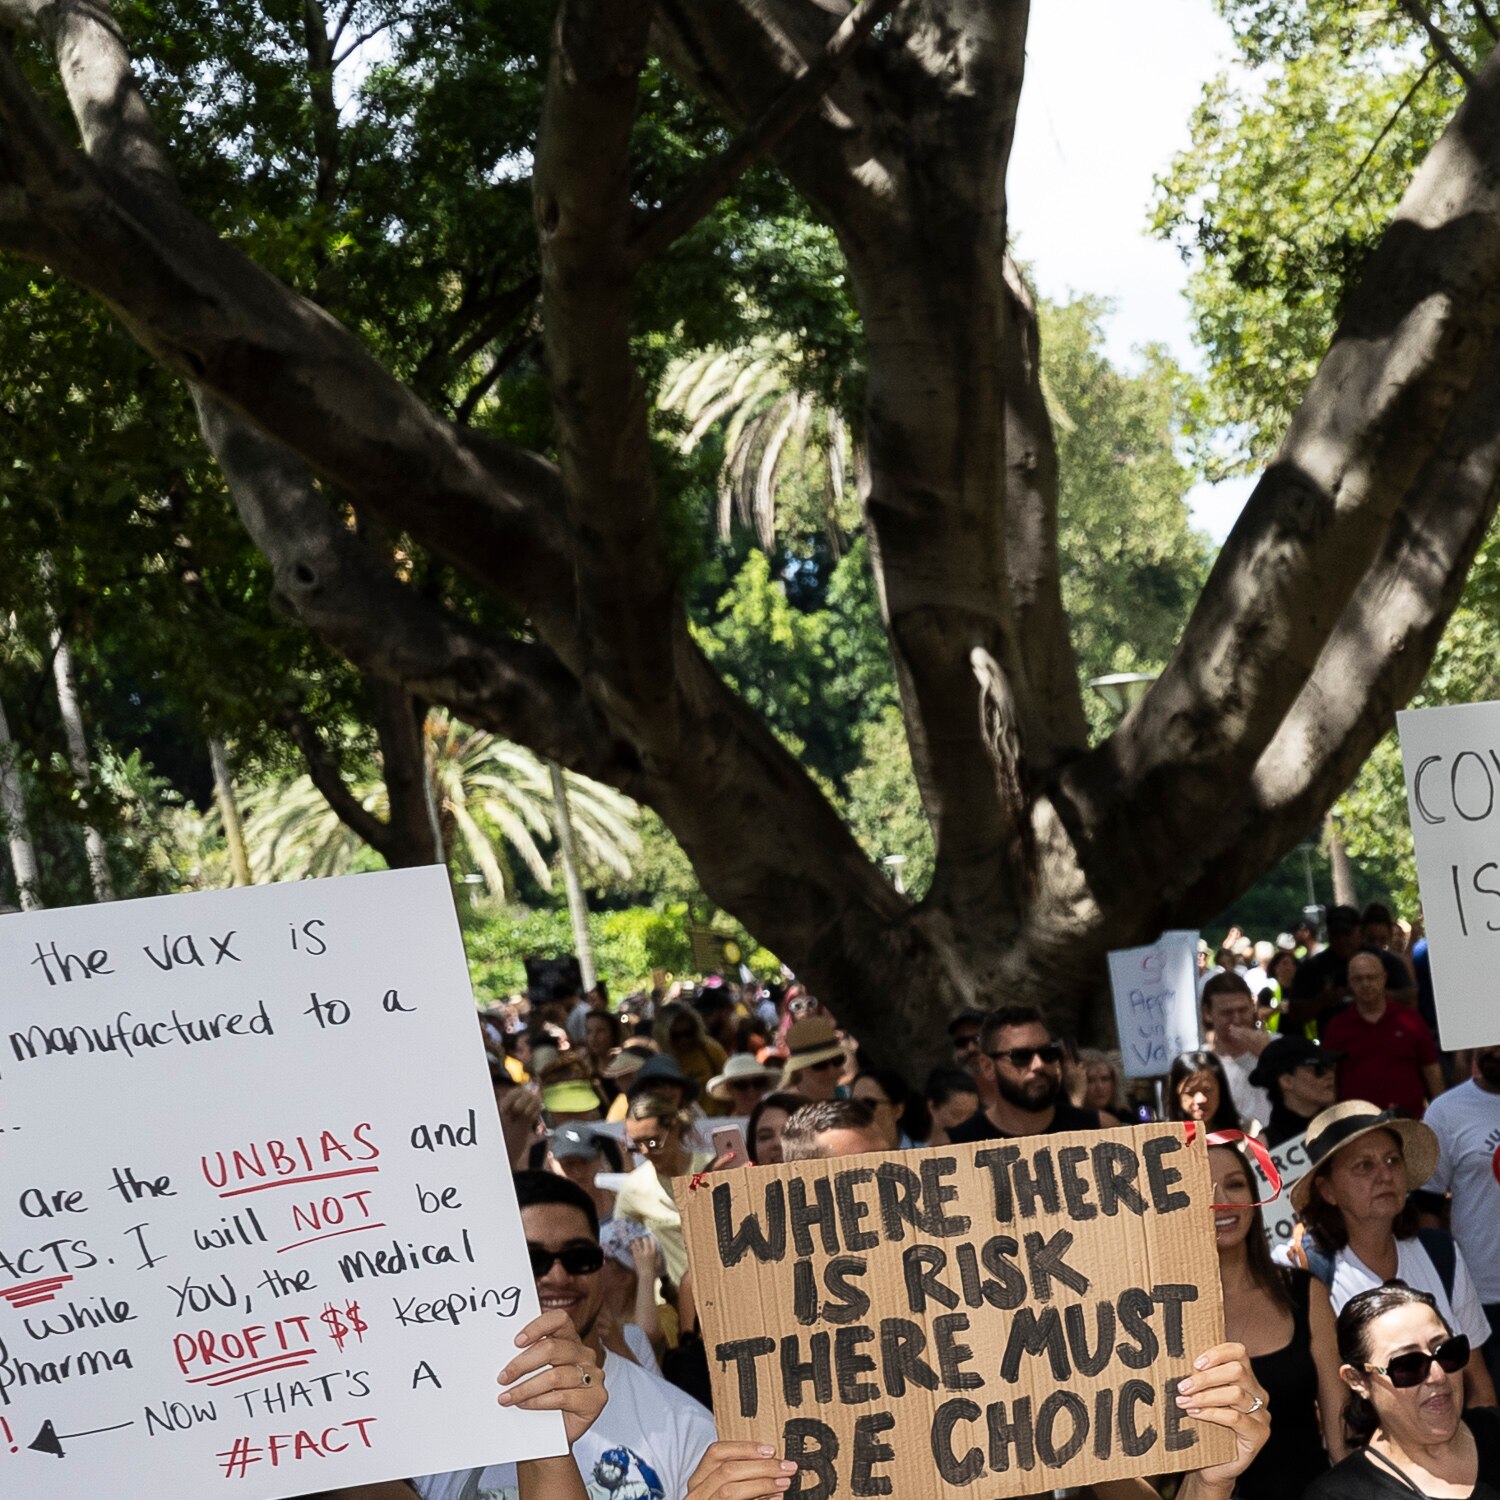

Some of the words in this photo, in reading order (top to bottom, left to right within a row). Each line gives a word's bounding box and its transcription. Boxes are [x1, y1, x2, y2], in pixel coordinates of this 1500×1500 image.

[31, 941, 115, 986] the
[143, 929, 242, 970] vax
[290, 919, 327, 955] is
[8, 1000, 275, 1062] manufactured
[304, 992, 350, 1028] to
[382, 987, 417, 1013] a
[20, 1187, 89, 1218] are
[108, 1166, 178, 1204] the
[201, 1121, 380, 1189] UNBIAS
[410, 1109, 478, 1148] and
[712, 1156, 972, 1268] WHERE
[975, 1136, 1191, 1223] THERE
[124, 1222, 170, 1270] I
[194, 1208, 266, 1250] will
[293, 1190, 373, 1233] NOT
[419, 1183, 463, 1214] be
[23, 1297, 138, 1340] while
[257, 1265, 319, 1302] the
[338, 1229, 476, 1285] medical
[792, 1256, 872, 1326] IS
[902, 1229, 1091, 1314] RISK
[143, 1401, 217, 1437] NOW
[235, 1368, 372, 1420] THAT'S
[410, 1360, 443, 1391] A
[717, 1312, 984, 1419] THERE
[1000, 1284, 1199, 1385] MUST
[216, 1416, 377, 1479] #FACT
[930, 1376, 1200, 1486] CHOICE
